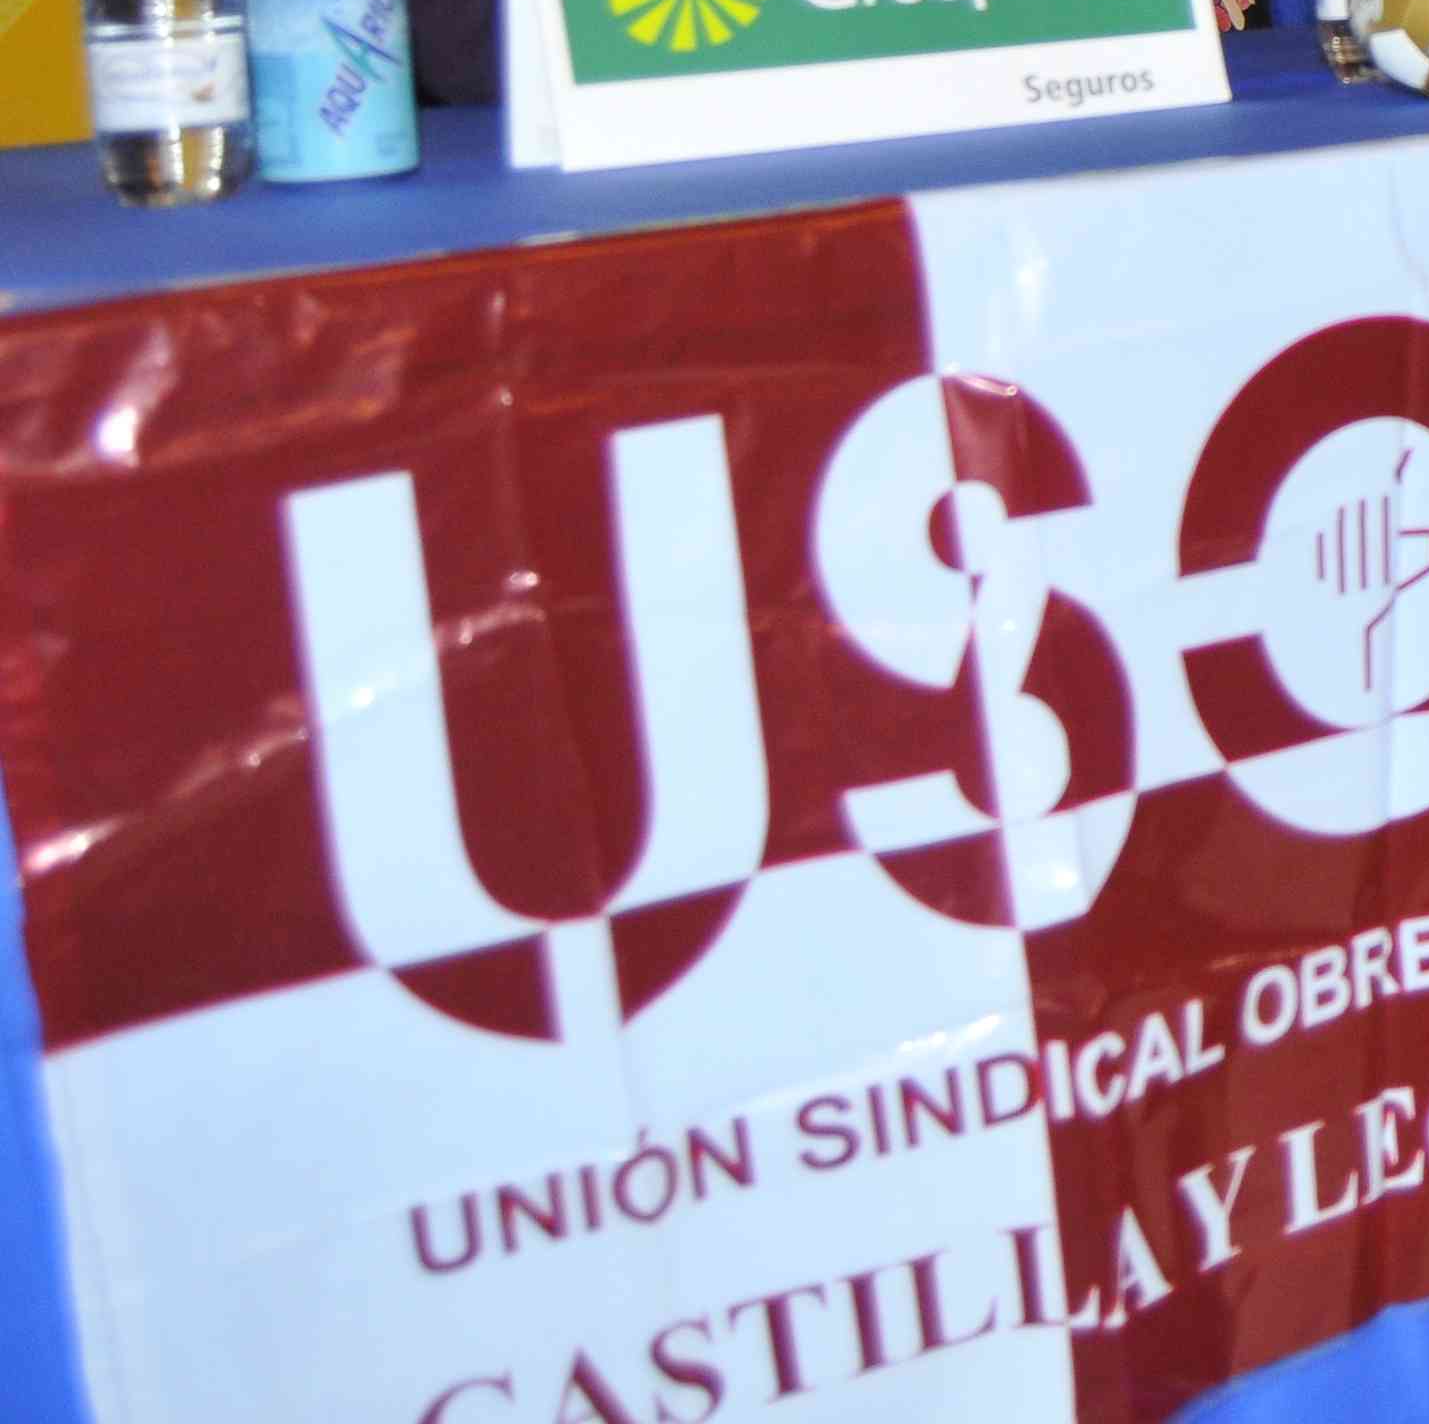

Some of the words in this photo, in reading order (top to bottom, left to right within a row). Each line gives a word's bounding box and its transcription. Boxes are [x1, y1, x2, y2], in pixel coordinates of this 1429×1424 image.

[1023, 69, 1155, 108] Seguros
[408, 1114, 758, 1279] UNIÓN
[798, 994, 1226, 1173] SINDICAL
[1177, 1145, 1258, 1274] Y
